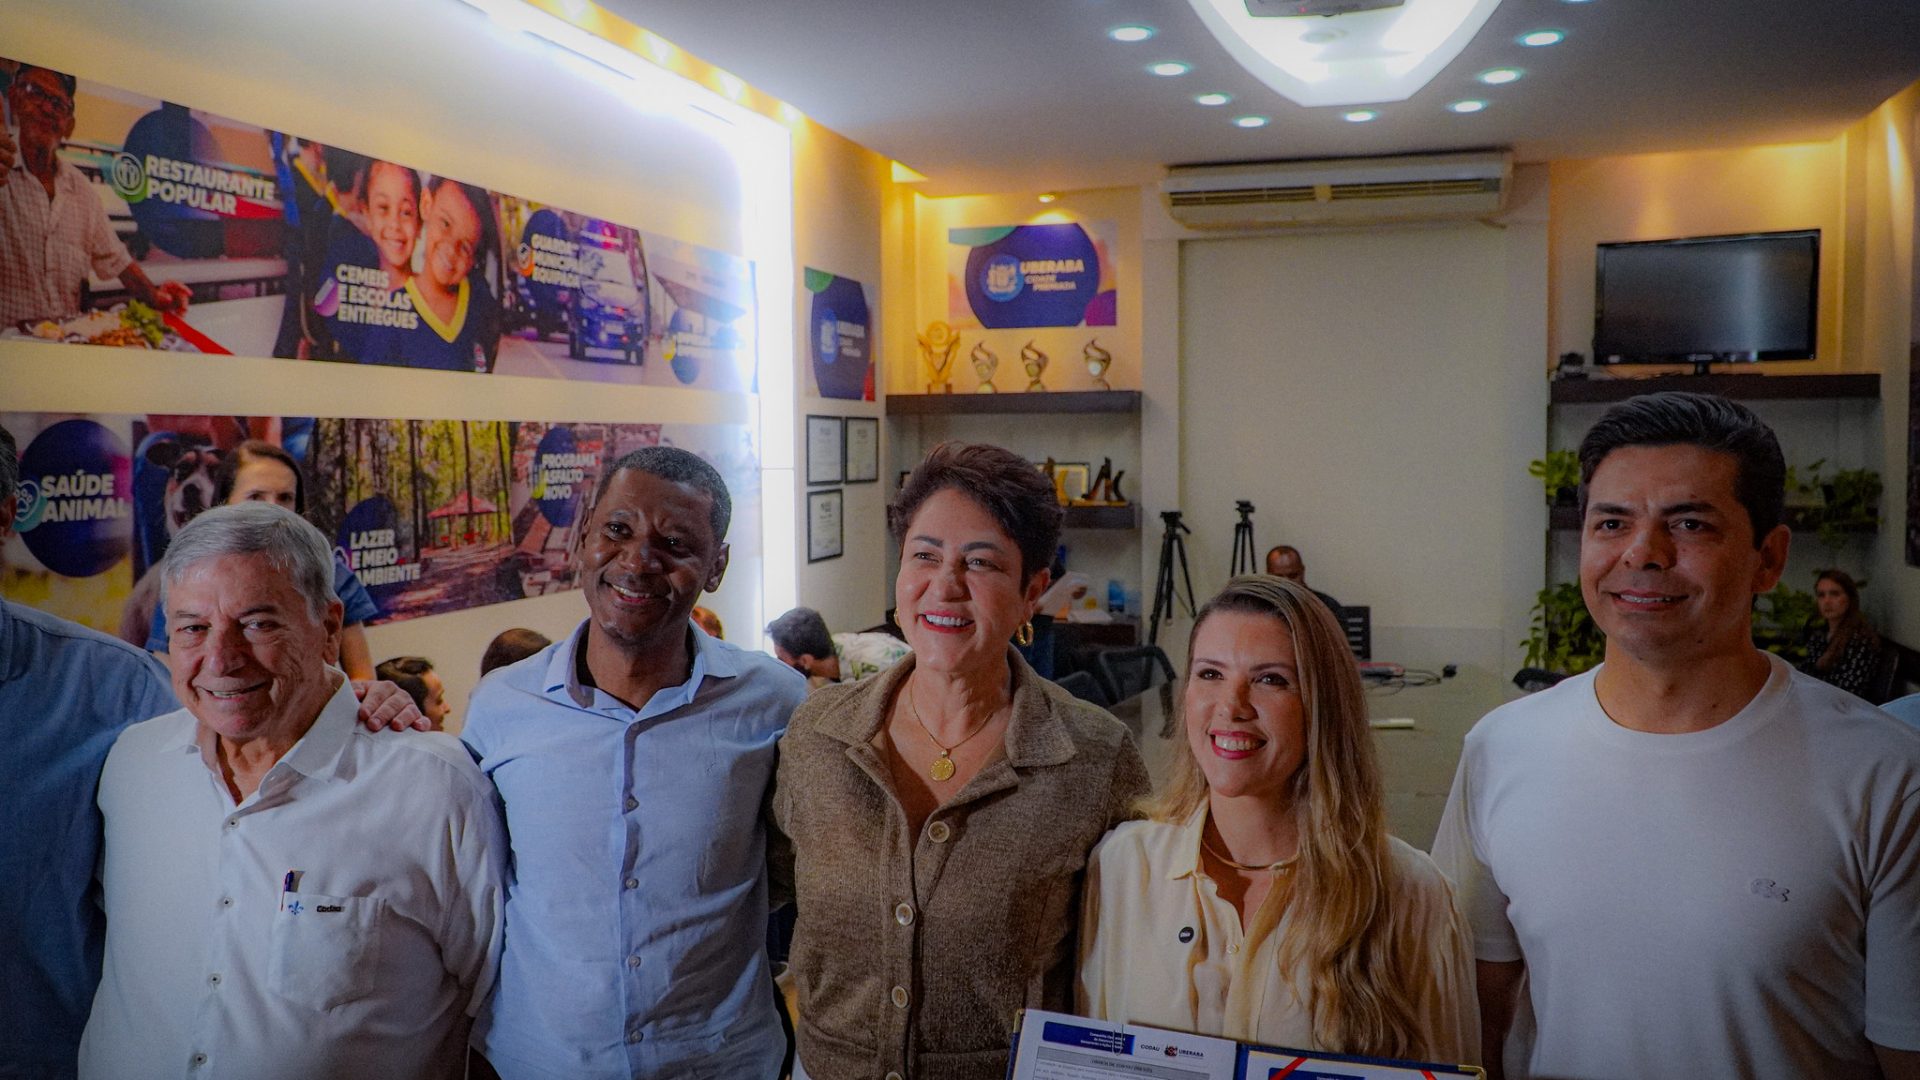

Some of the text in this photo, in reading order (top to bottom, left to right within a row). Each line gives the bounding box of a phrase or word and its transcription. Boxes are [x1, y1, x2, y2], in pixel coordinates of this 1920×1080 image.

[145, 154, 275, 200] RESTAURANTE
[146, 177, 237, 215] POPULAR
[336, 264, 389, 289] CEMEIS
[1020, 259, 1085, 274] UBERABA
[338, 286, 411, 310] E ESCOLAS
[338, 304, 418, 330] ENTREGUES
[40, 468, 114, 498] SAÚDE
[543, 485, 572, 500] NOVO
[41, 496, 129, 523] ANIMAL
[350, 529, 395, 549] LAZER
[351, 547, 399, 570] E MEIO
[355, 563, 421, 587] AMBIENTE
[1140, 1044, 1161, 1052] CODAU
[1178, 1049, 1205, 1058] UBERABA
